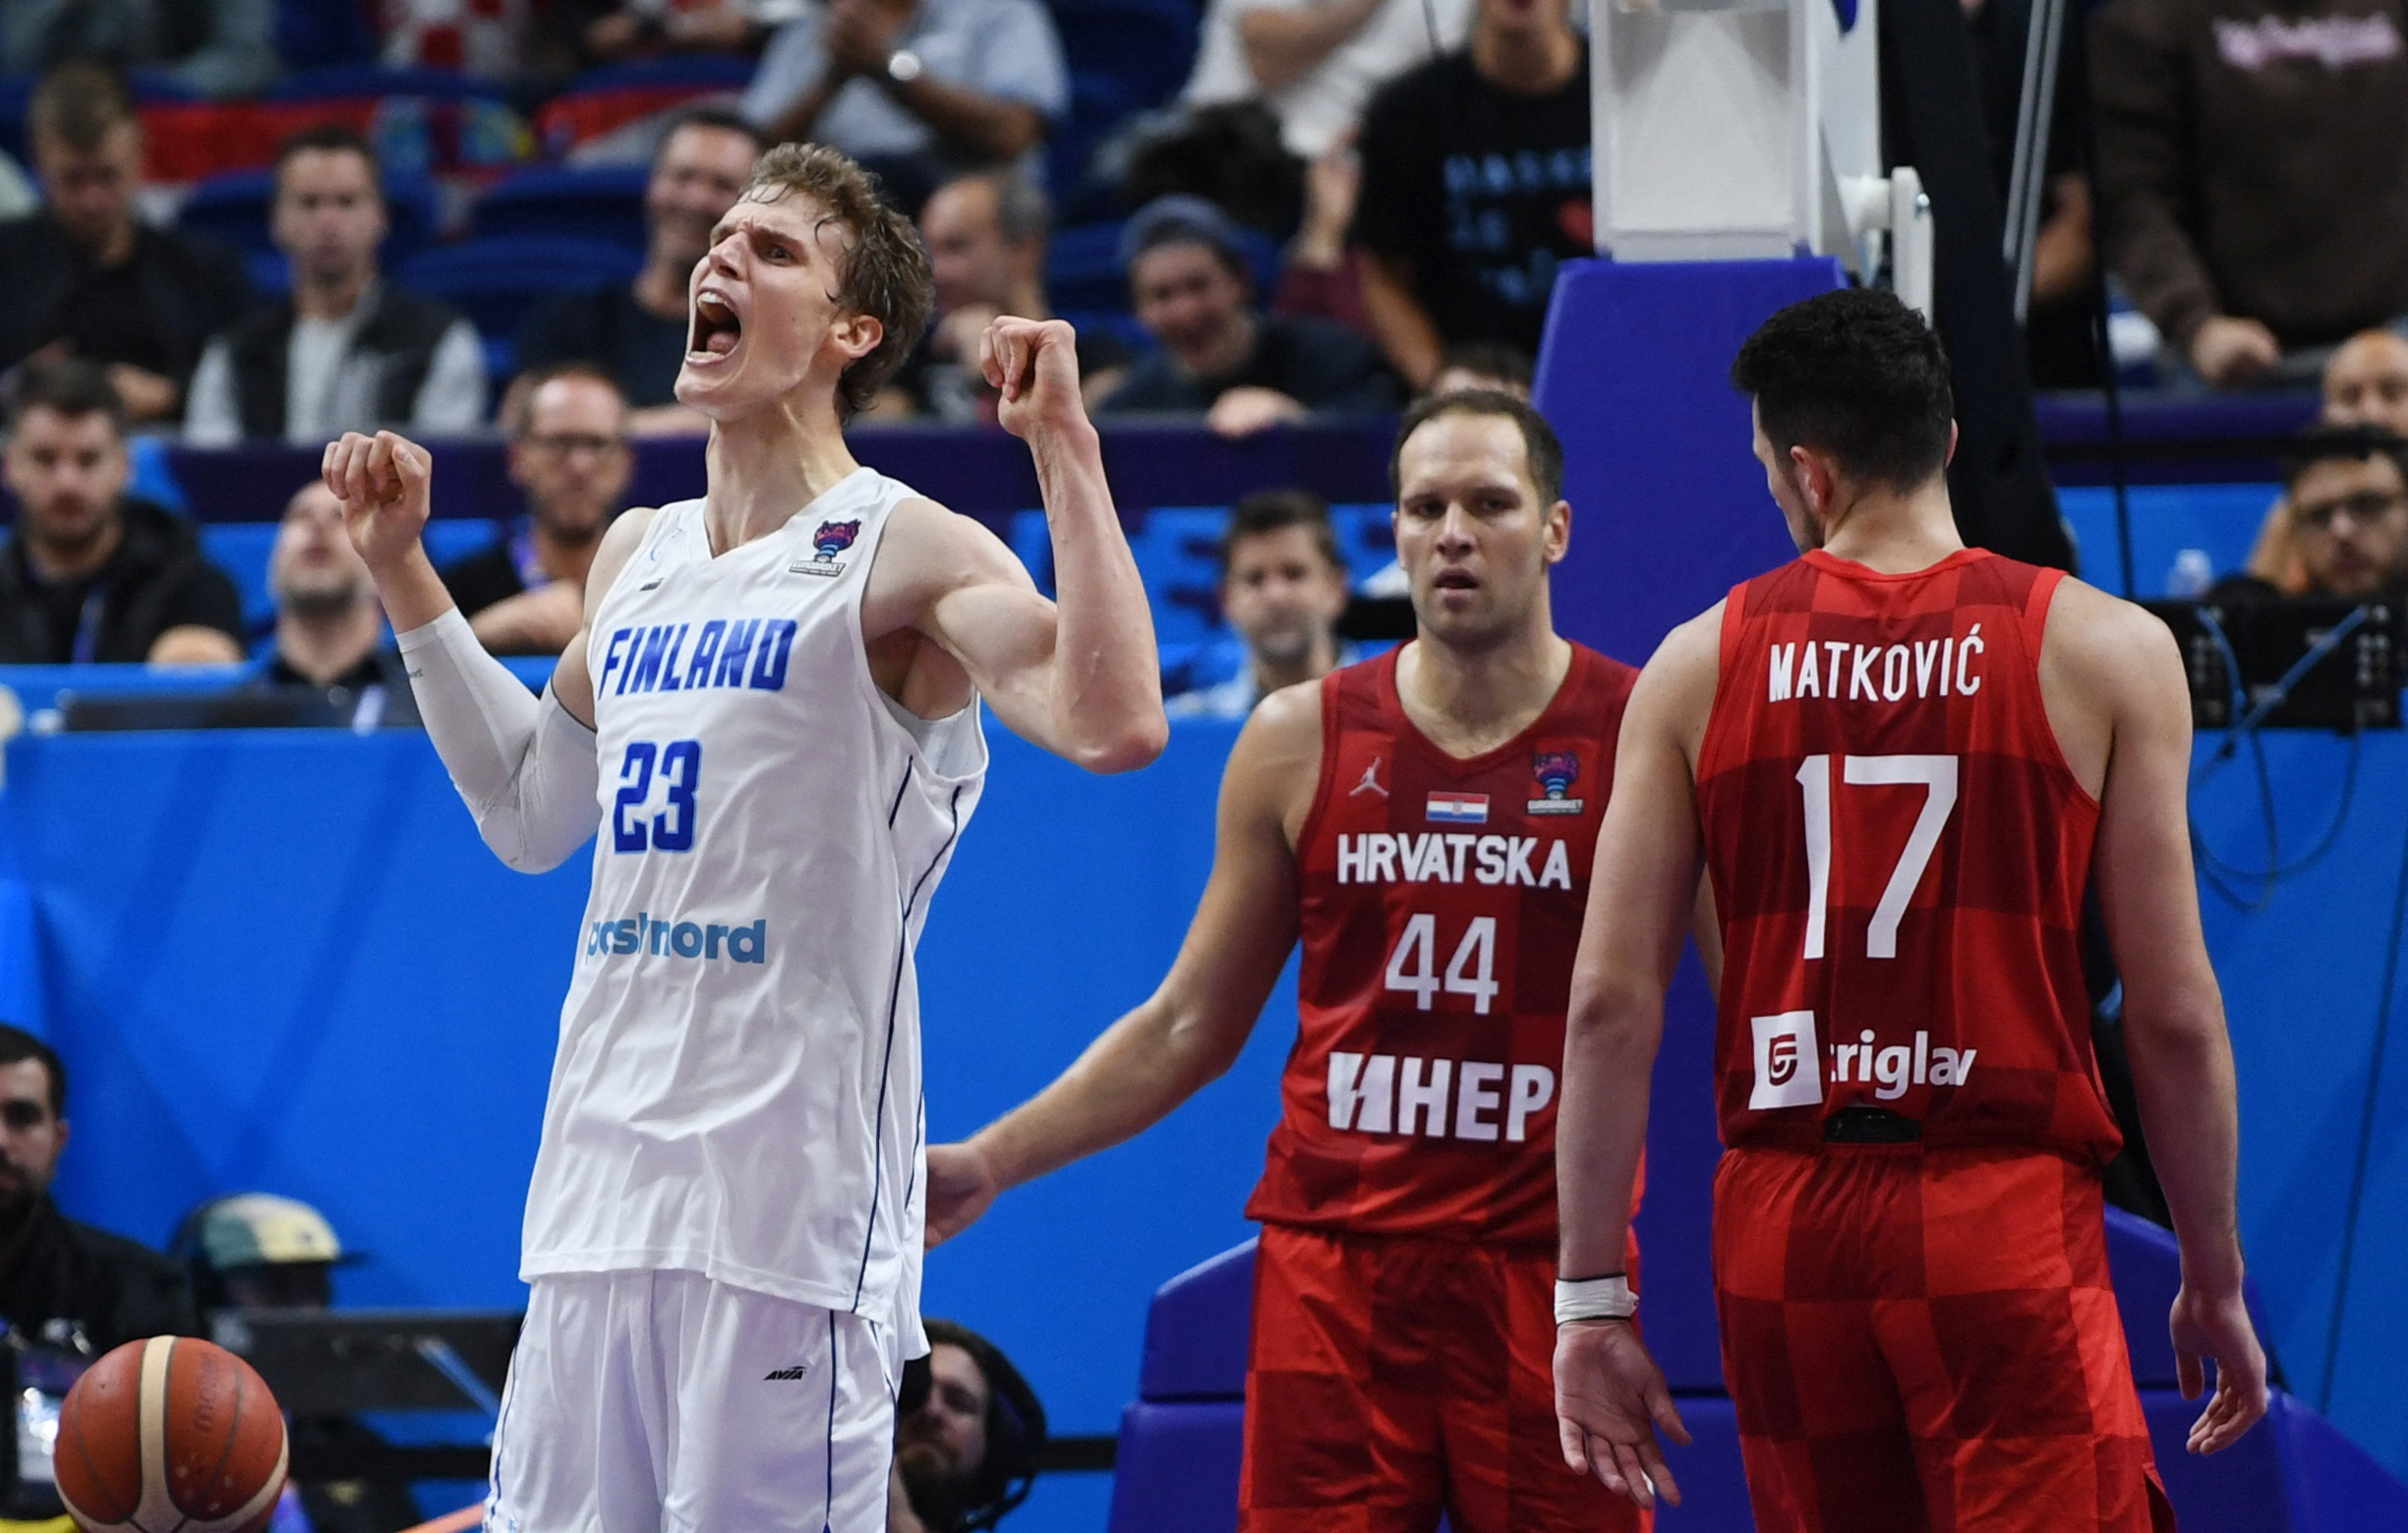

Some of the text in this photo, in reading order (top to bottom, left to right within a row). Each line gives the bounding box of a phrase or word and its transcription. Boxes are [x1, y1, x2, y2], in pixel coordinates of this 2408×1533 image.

[598, 619, 798, 700] FINLAND
[1768, 622, 1984, 703] MATKOVIĆ
[613, 738, 703, 855] 23
[1337, 832, 1572, 890] HRVATSKA
[1794, 753, 1959, 960] 17
[1383, 913, 1499, 1015] 44
[1397, 1055, 1555, 1143] HEP
[1829, 1029, 1977, 1100] riglav
